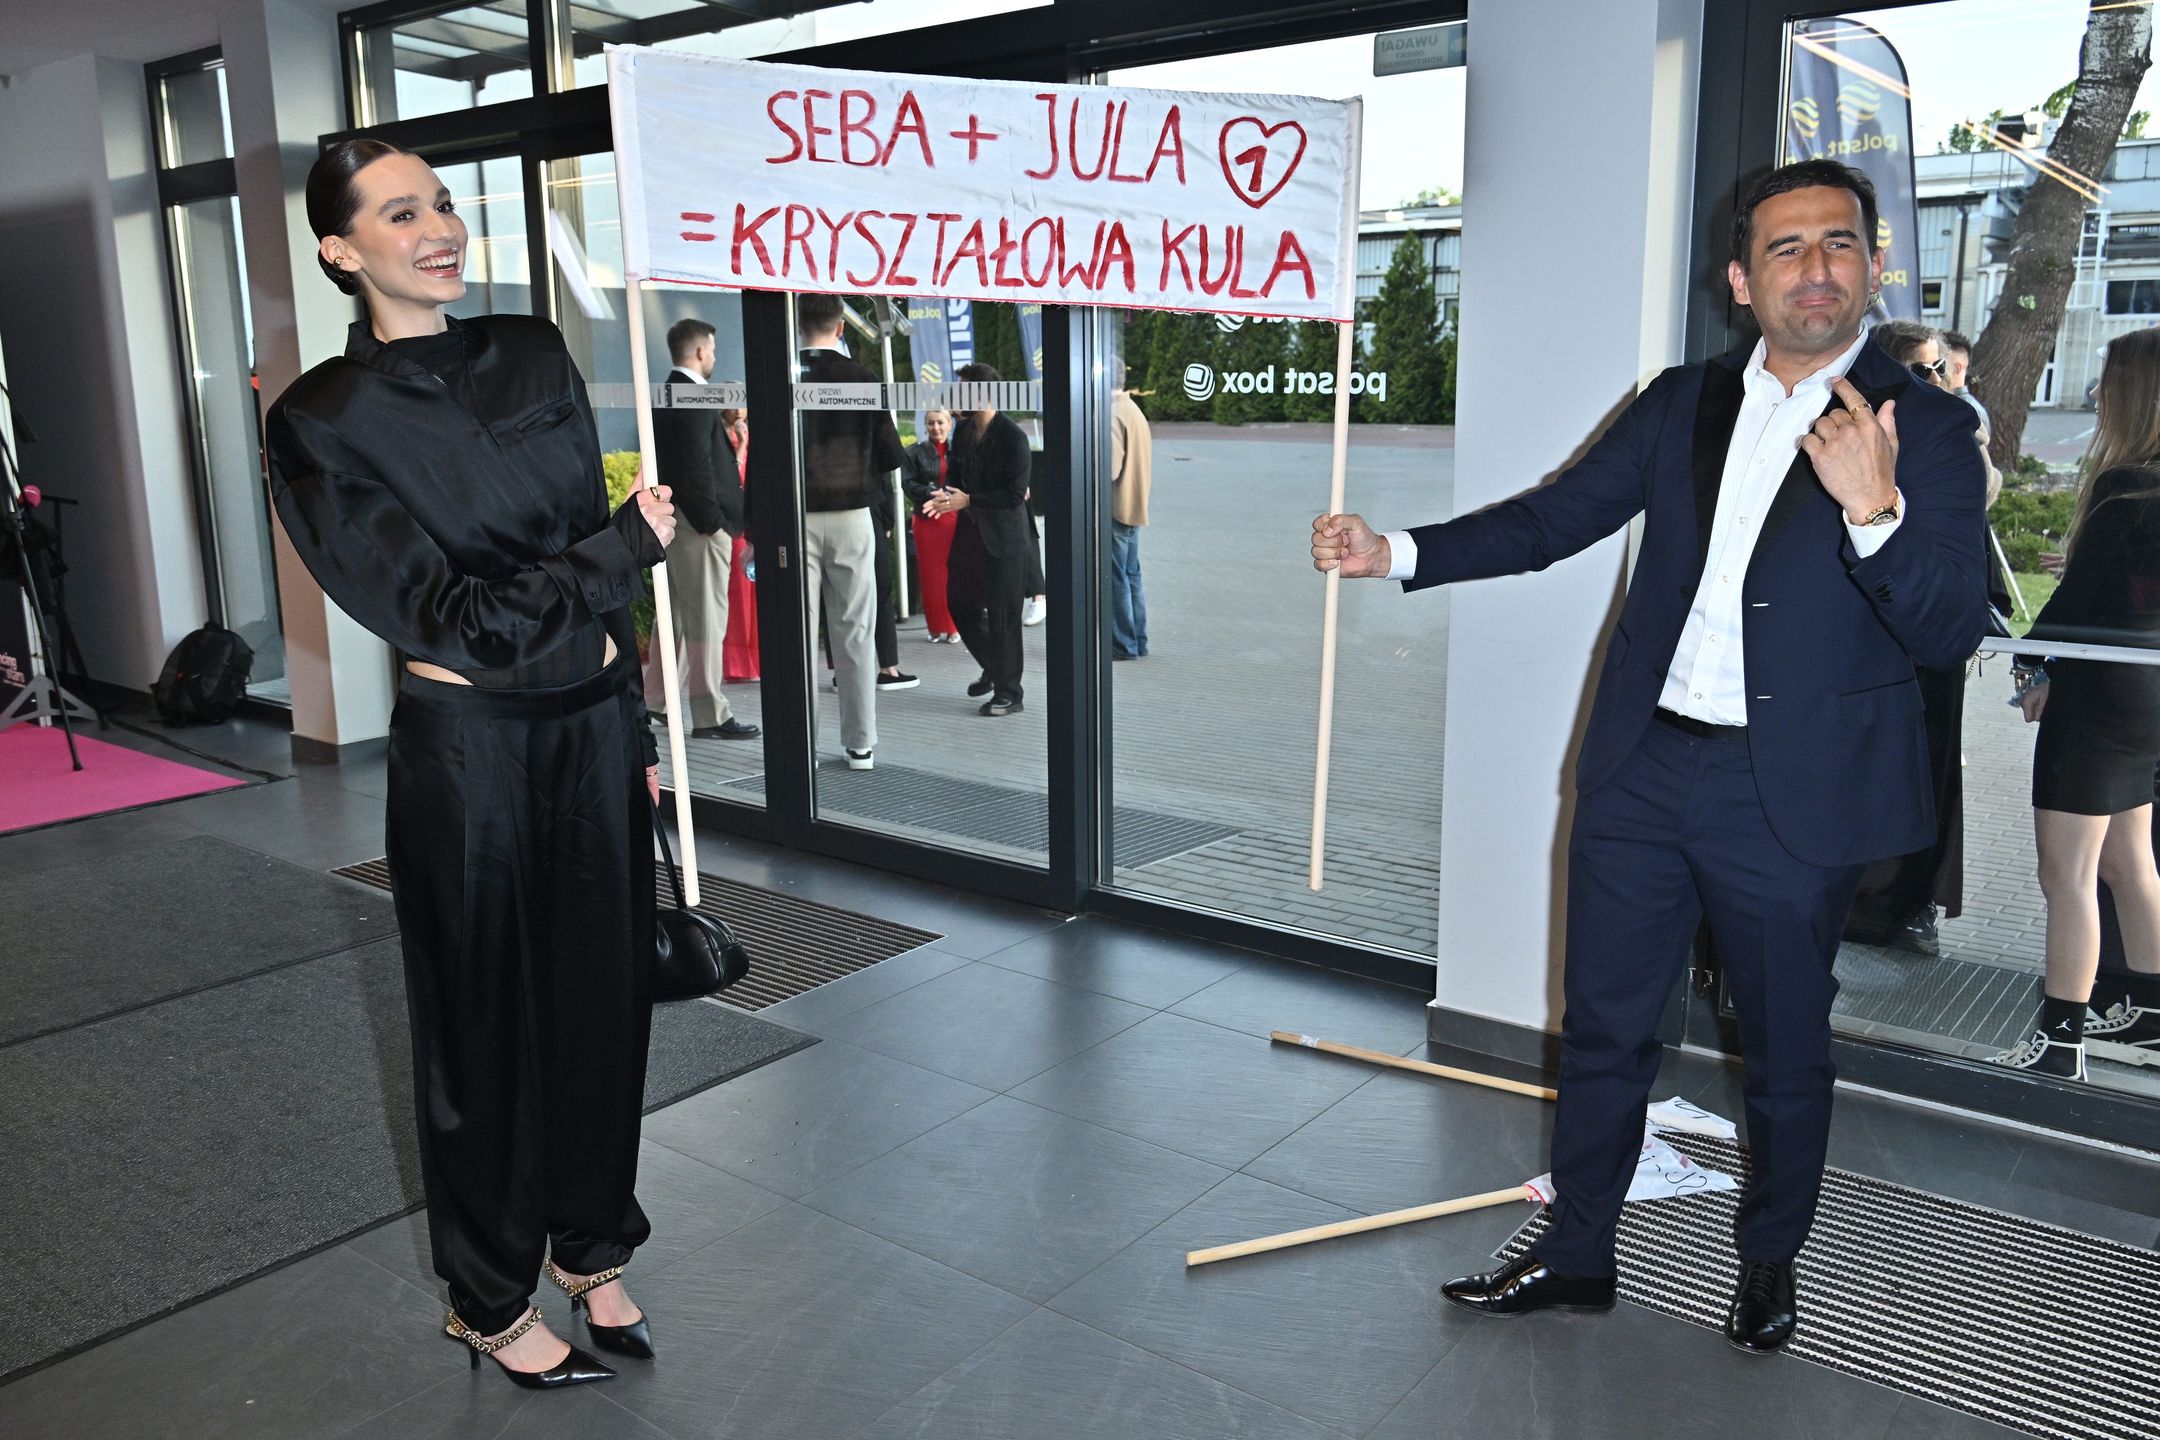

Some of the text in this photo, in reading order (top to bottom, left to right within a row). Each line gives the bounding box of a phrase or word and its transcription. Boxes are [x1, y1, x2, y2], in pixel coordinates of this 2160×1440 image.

[766, 89, 934, 167] SEBA
[1026, 93, 1186, 182] JULA
[731, 203, 1135, 293] KRYSZTAŁOWA
[1159, 219, 1316, 299] KULA
[818, 387, 842, 396] DRZWI
[676, 396, 725, 404] AUTOMATYCZNE
[819, 397, 877, 406] AUTOMATYCZNE
